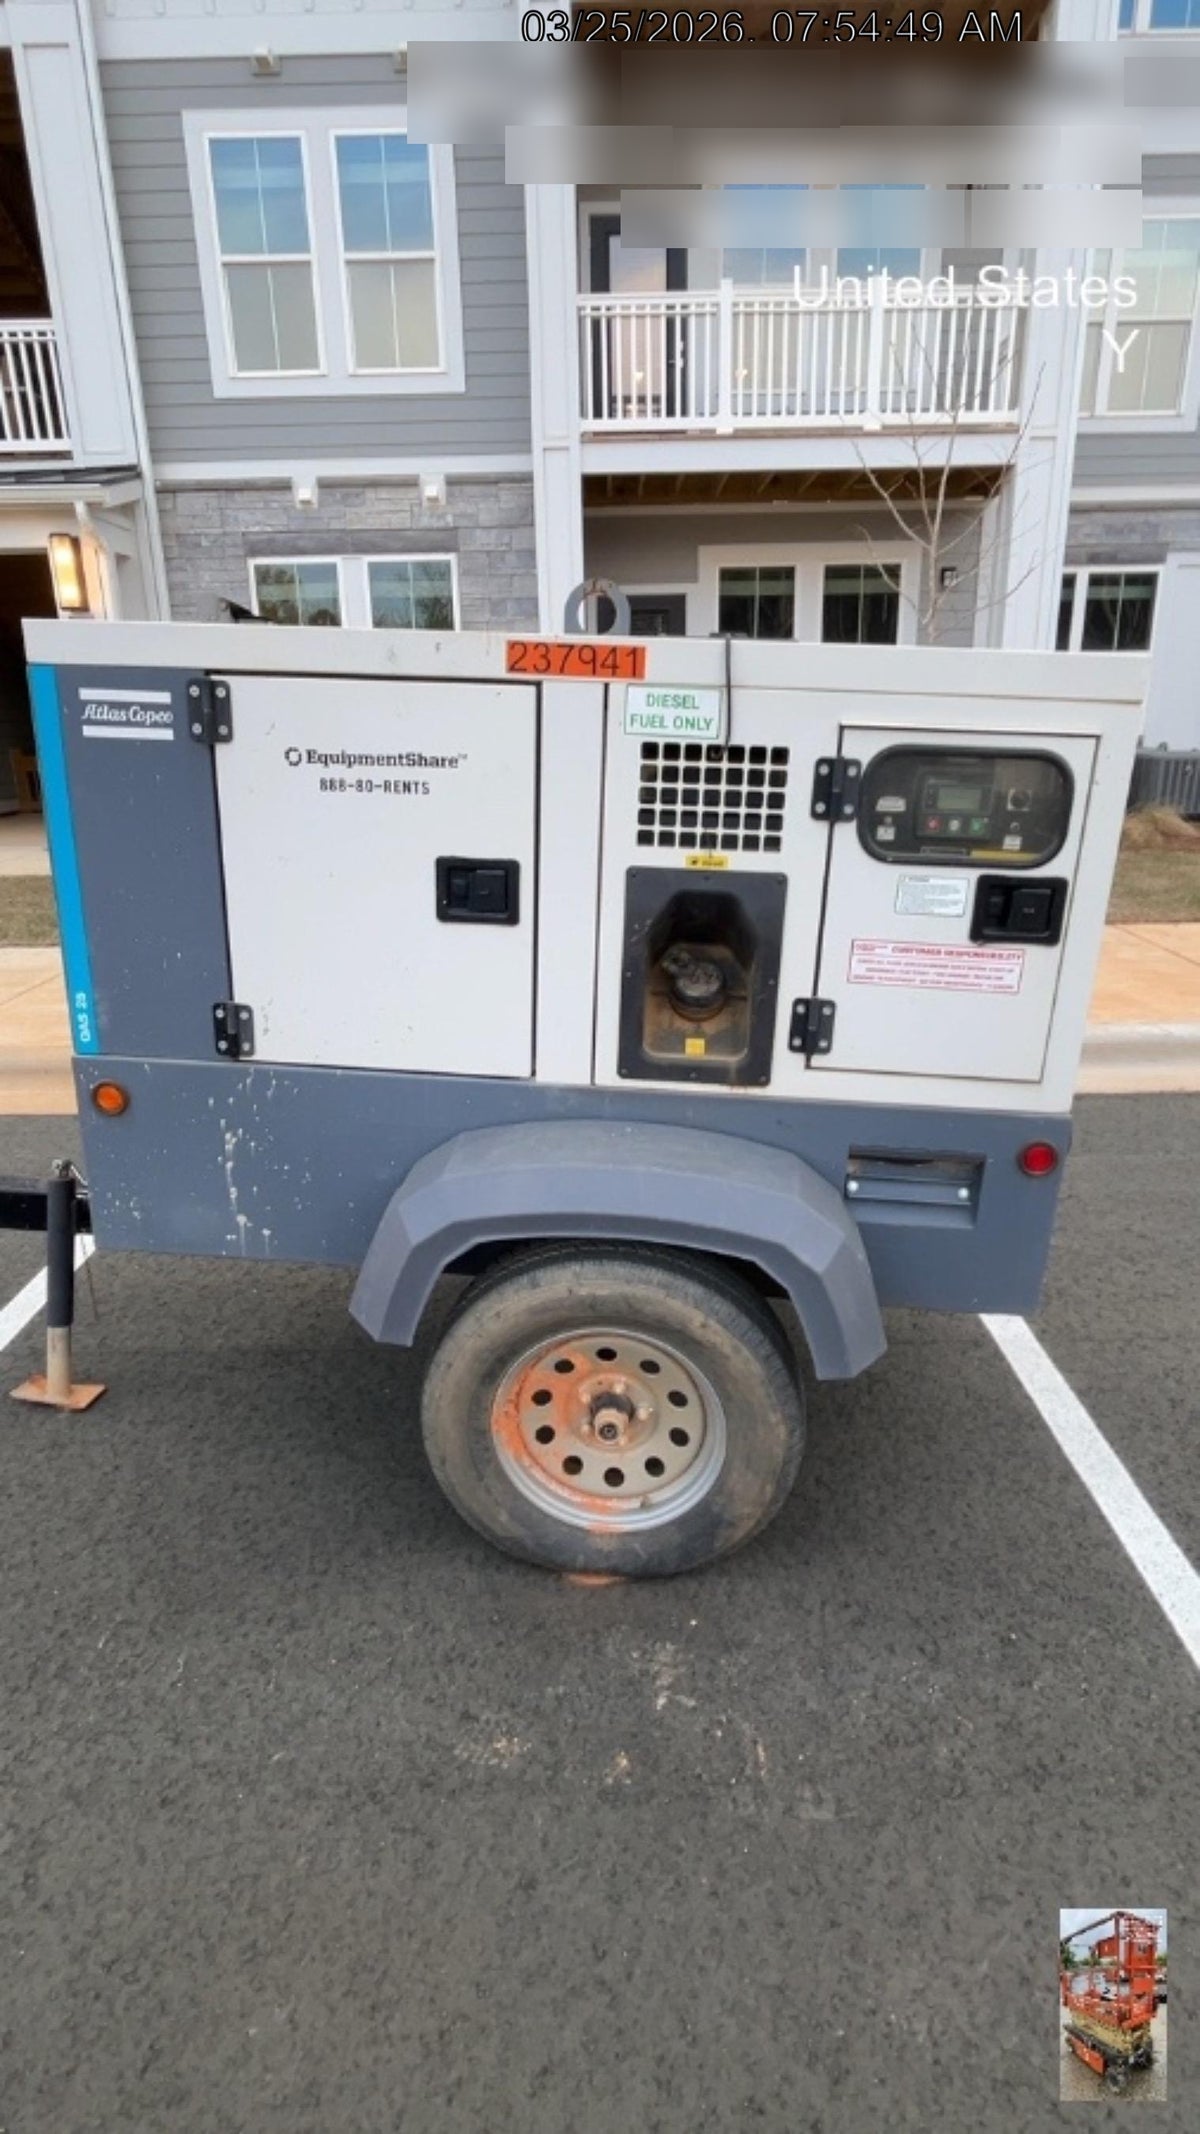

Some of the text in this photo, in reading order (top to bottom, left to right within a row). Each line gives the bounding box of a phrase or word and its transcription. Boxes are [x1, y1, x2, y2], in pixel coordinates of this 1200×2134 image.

[508, 641, 638, 678] 237941
[645, 693, 700, 710] DIESEL
[81, 703, 174, 726] Atlas Copco
[630, 713, 714, 731] FUEL ONLY
[319, 777, 430, 796] 888-80-RENTS
